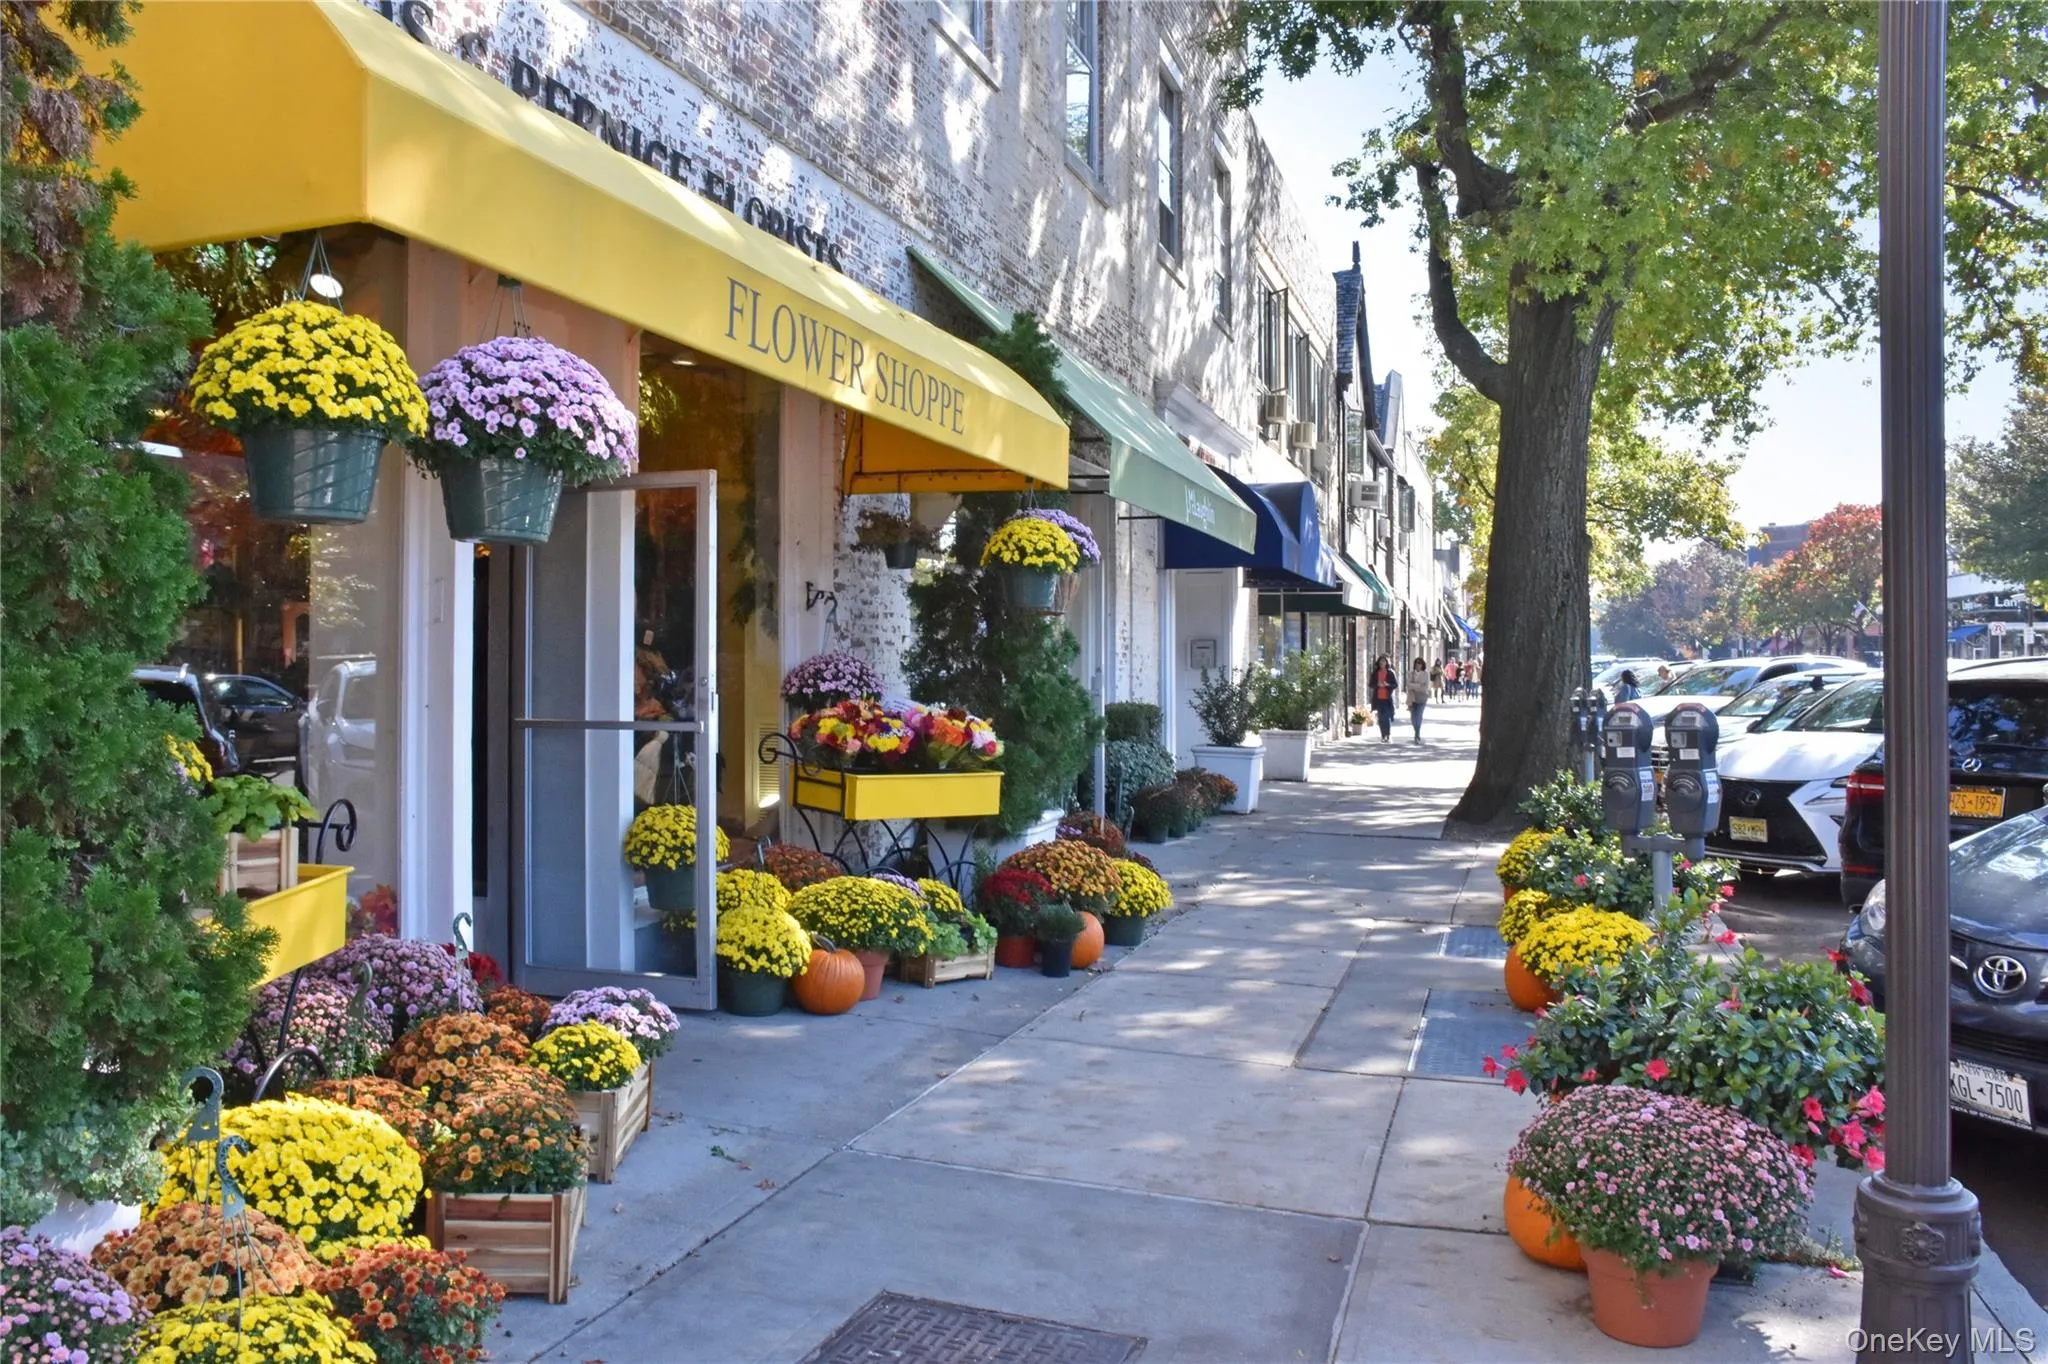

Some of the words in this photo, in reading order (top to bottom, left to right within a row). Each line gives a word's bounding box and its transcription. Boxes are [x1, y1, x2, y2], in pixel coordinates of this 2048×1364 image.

[725, 276, 867, 396] FLOWER
[875, 351, 965, 436] SHOPPE
[1994, 596, 2019, 608] Lan
[1986, 1080, 2024, 1114] 7500
